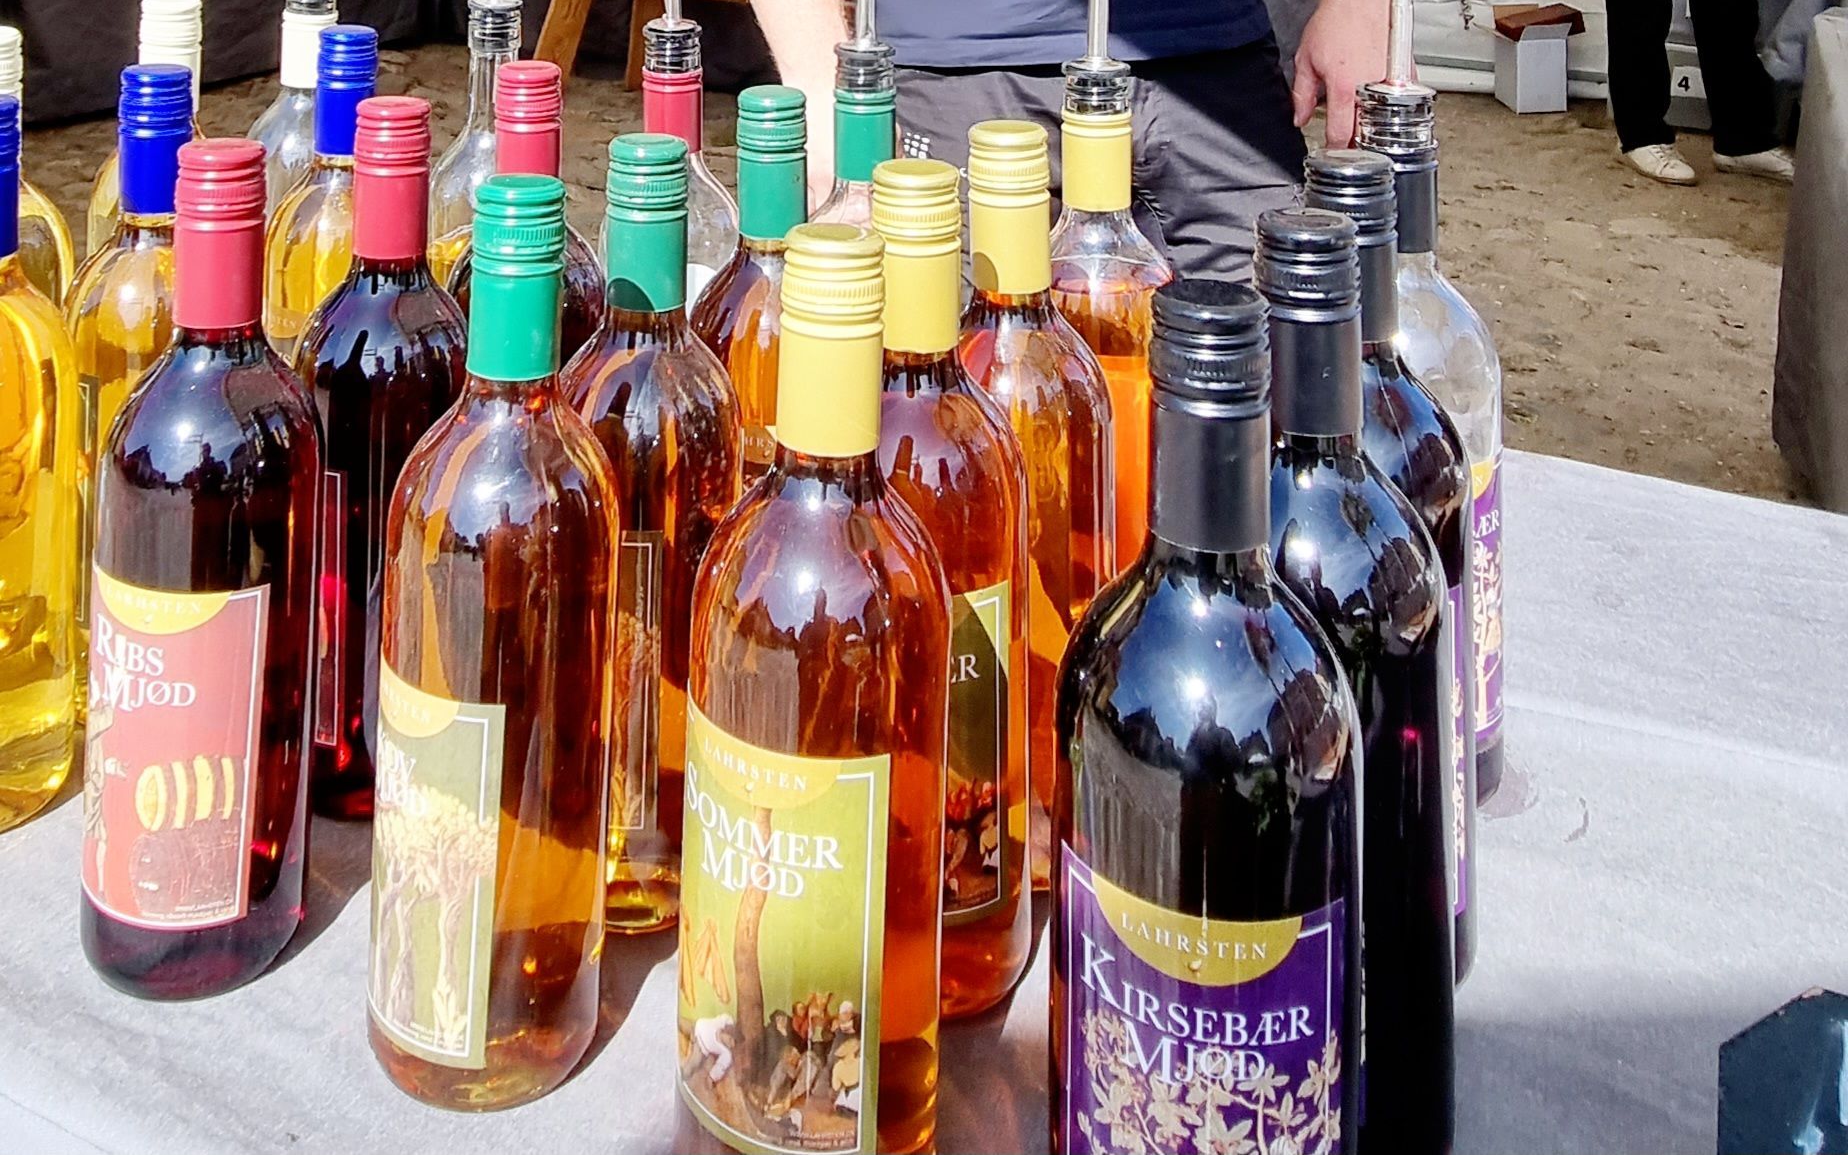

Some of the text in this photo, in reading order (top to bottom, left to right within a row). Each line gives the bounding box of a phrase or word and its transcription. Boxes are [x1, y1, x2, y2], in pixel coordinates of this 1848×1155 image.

[1677, 76, 1690, 92] 4
[102, 661, 197, 713] MJØD
[703, 737, 807, 791] LAHRSTEN
[686, 760, 844, 870] SOMMER
[701, 827, 805, 898] MJØD
[1121, 912, 1268, 960] LAHRSTEN
[1078, 932, 1315, 1046] KIRSEBÆR
[1120, 1016, 1266, 1086] MJØD
